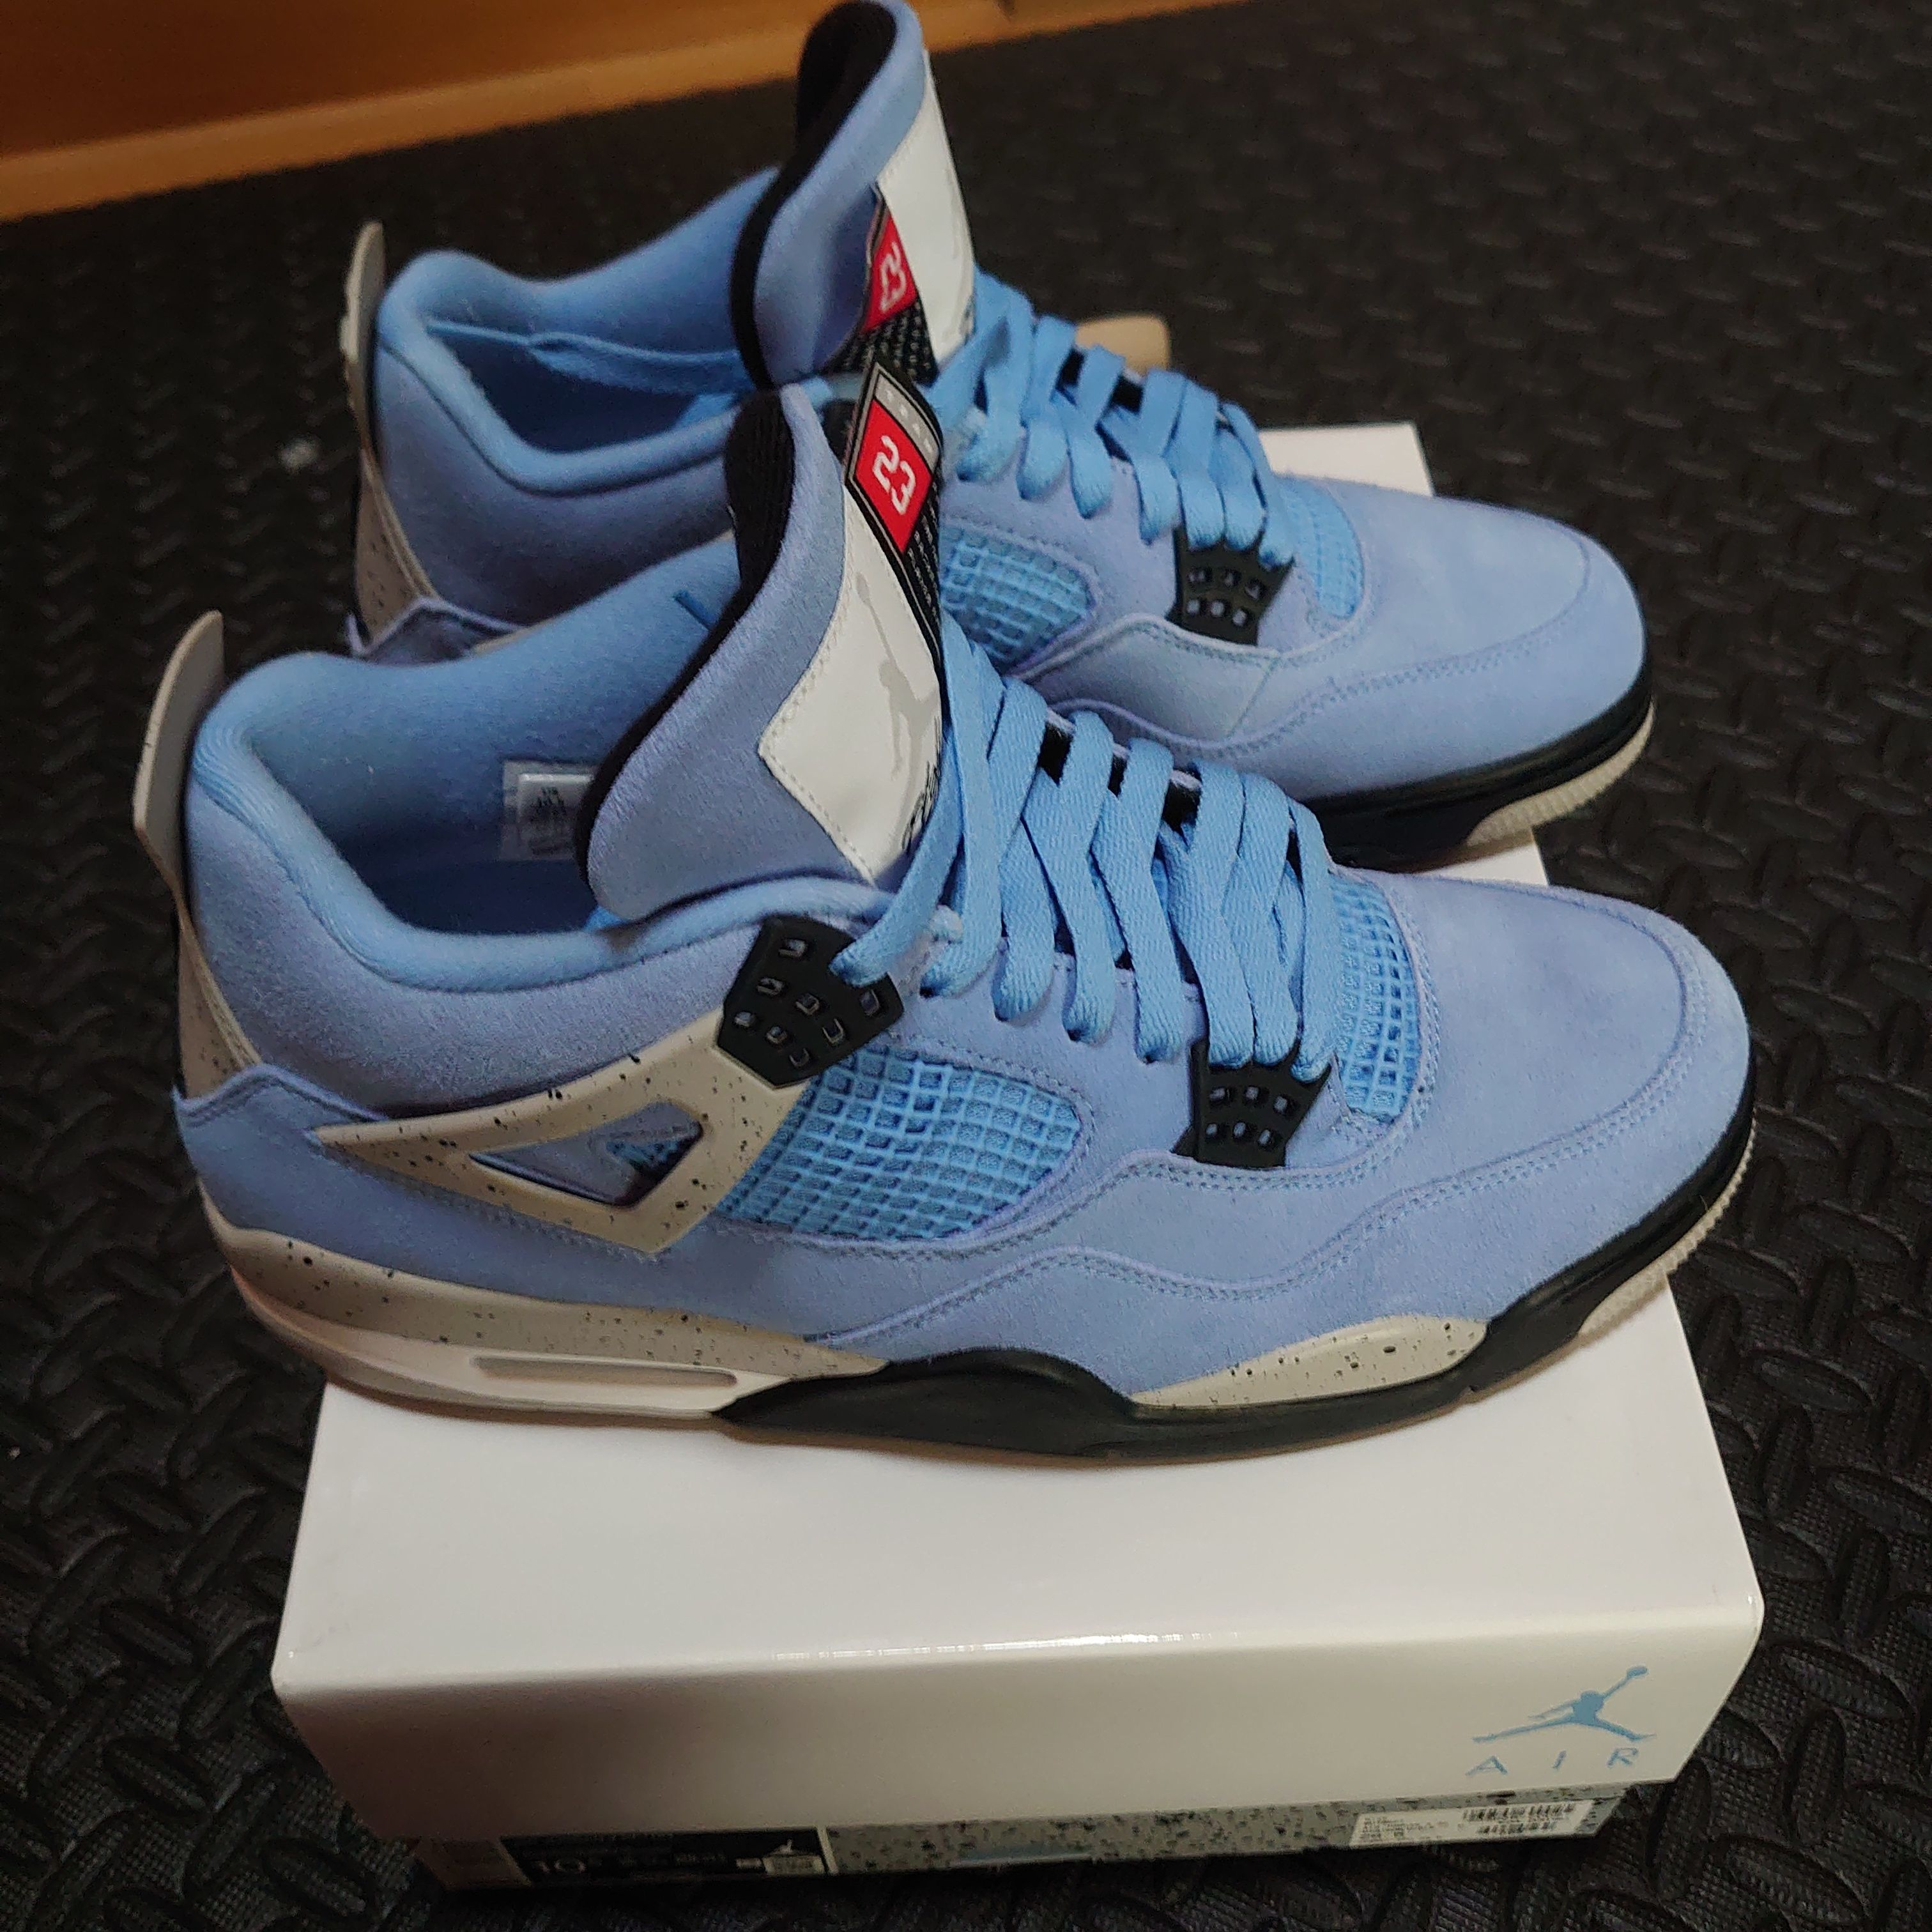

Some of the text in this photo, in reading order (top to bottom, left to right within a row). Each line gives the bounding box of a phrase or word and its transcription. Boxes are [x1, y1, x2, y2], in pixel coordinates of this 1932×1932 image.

[879, 241, 907, 312] 23
[872, 434, 917, 516] 23
[1465, 1747, 1639, 1777] AIR
